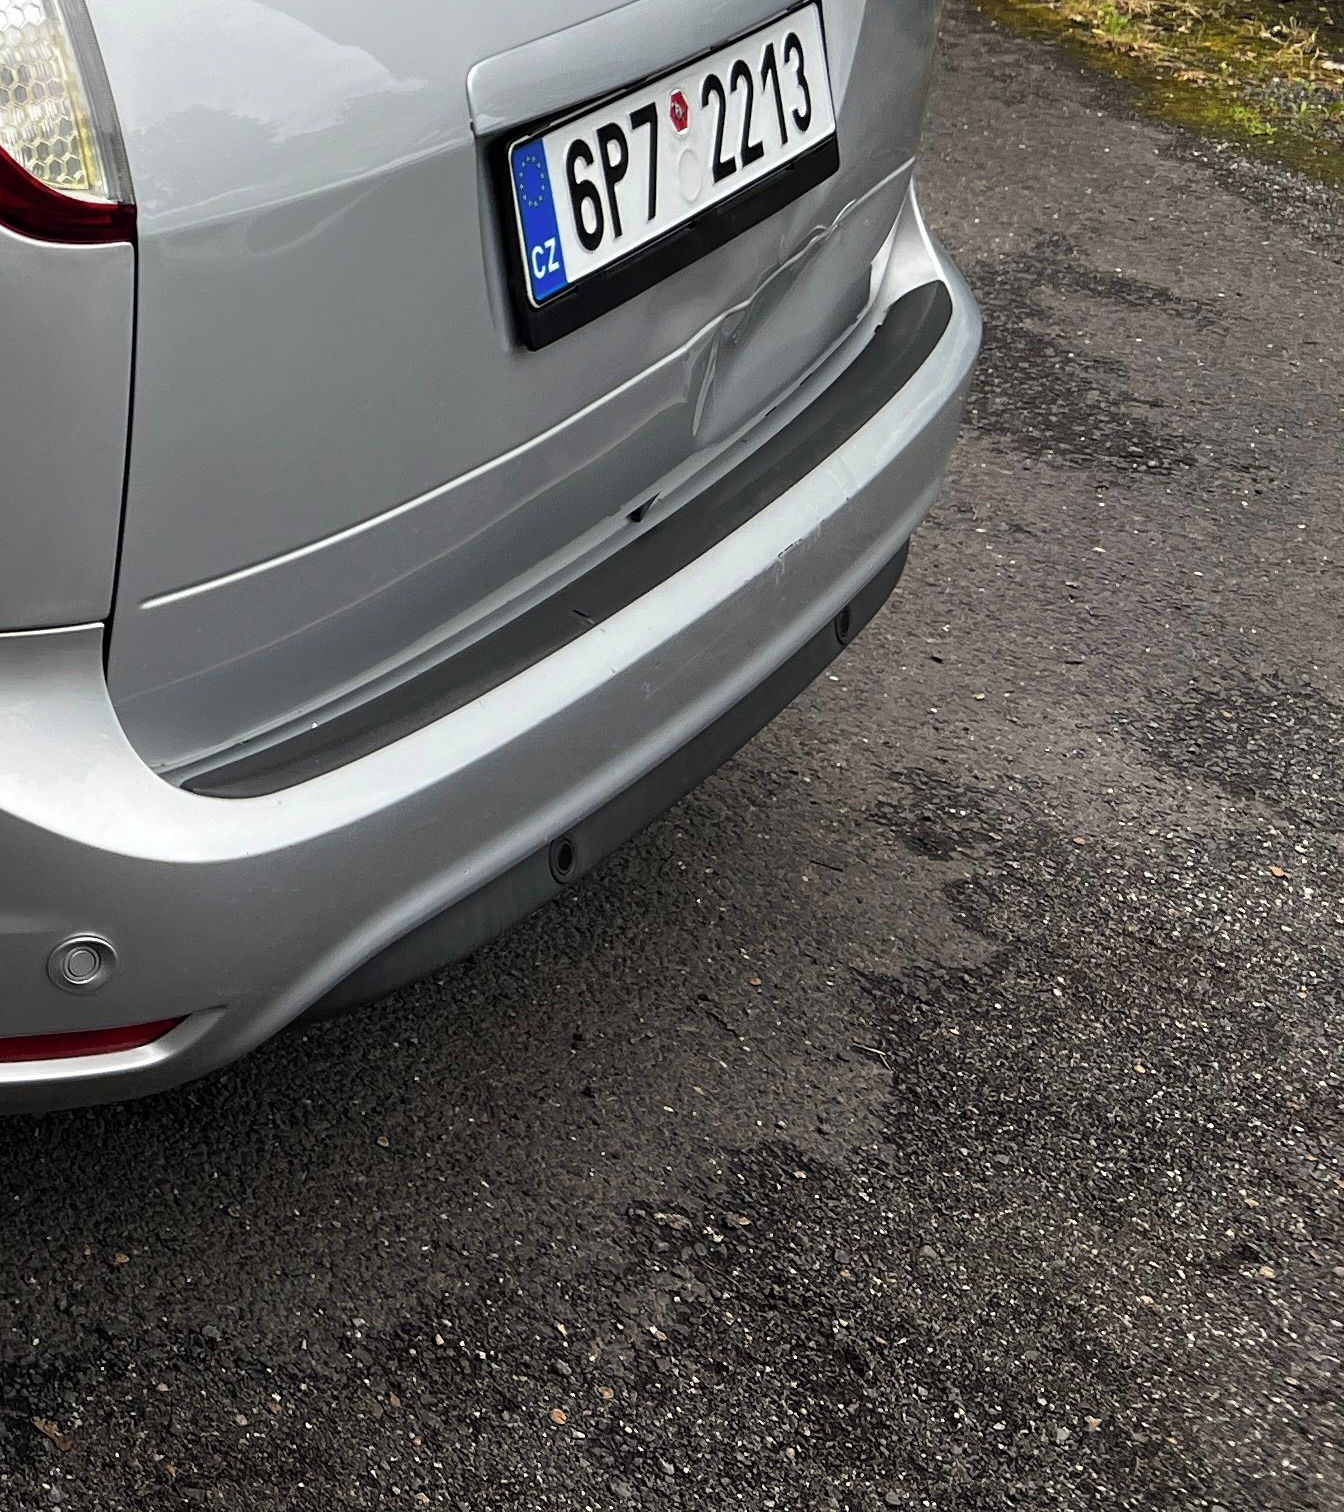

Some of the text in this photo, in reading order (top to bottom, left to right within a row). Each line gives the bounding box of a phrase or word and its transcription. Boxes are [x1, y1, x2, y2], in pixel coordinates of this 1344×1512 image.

[565, 31, 812, 252] 6P7 2213
[531, 236, 560, 279] CZ
